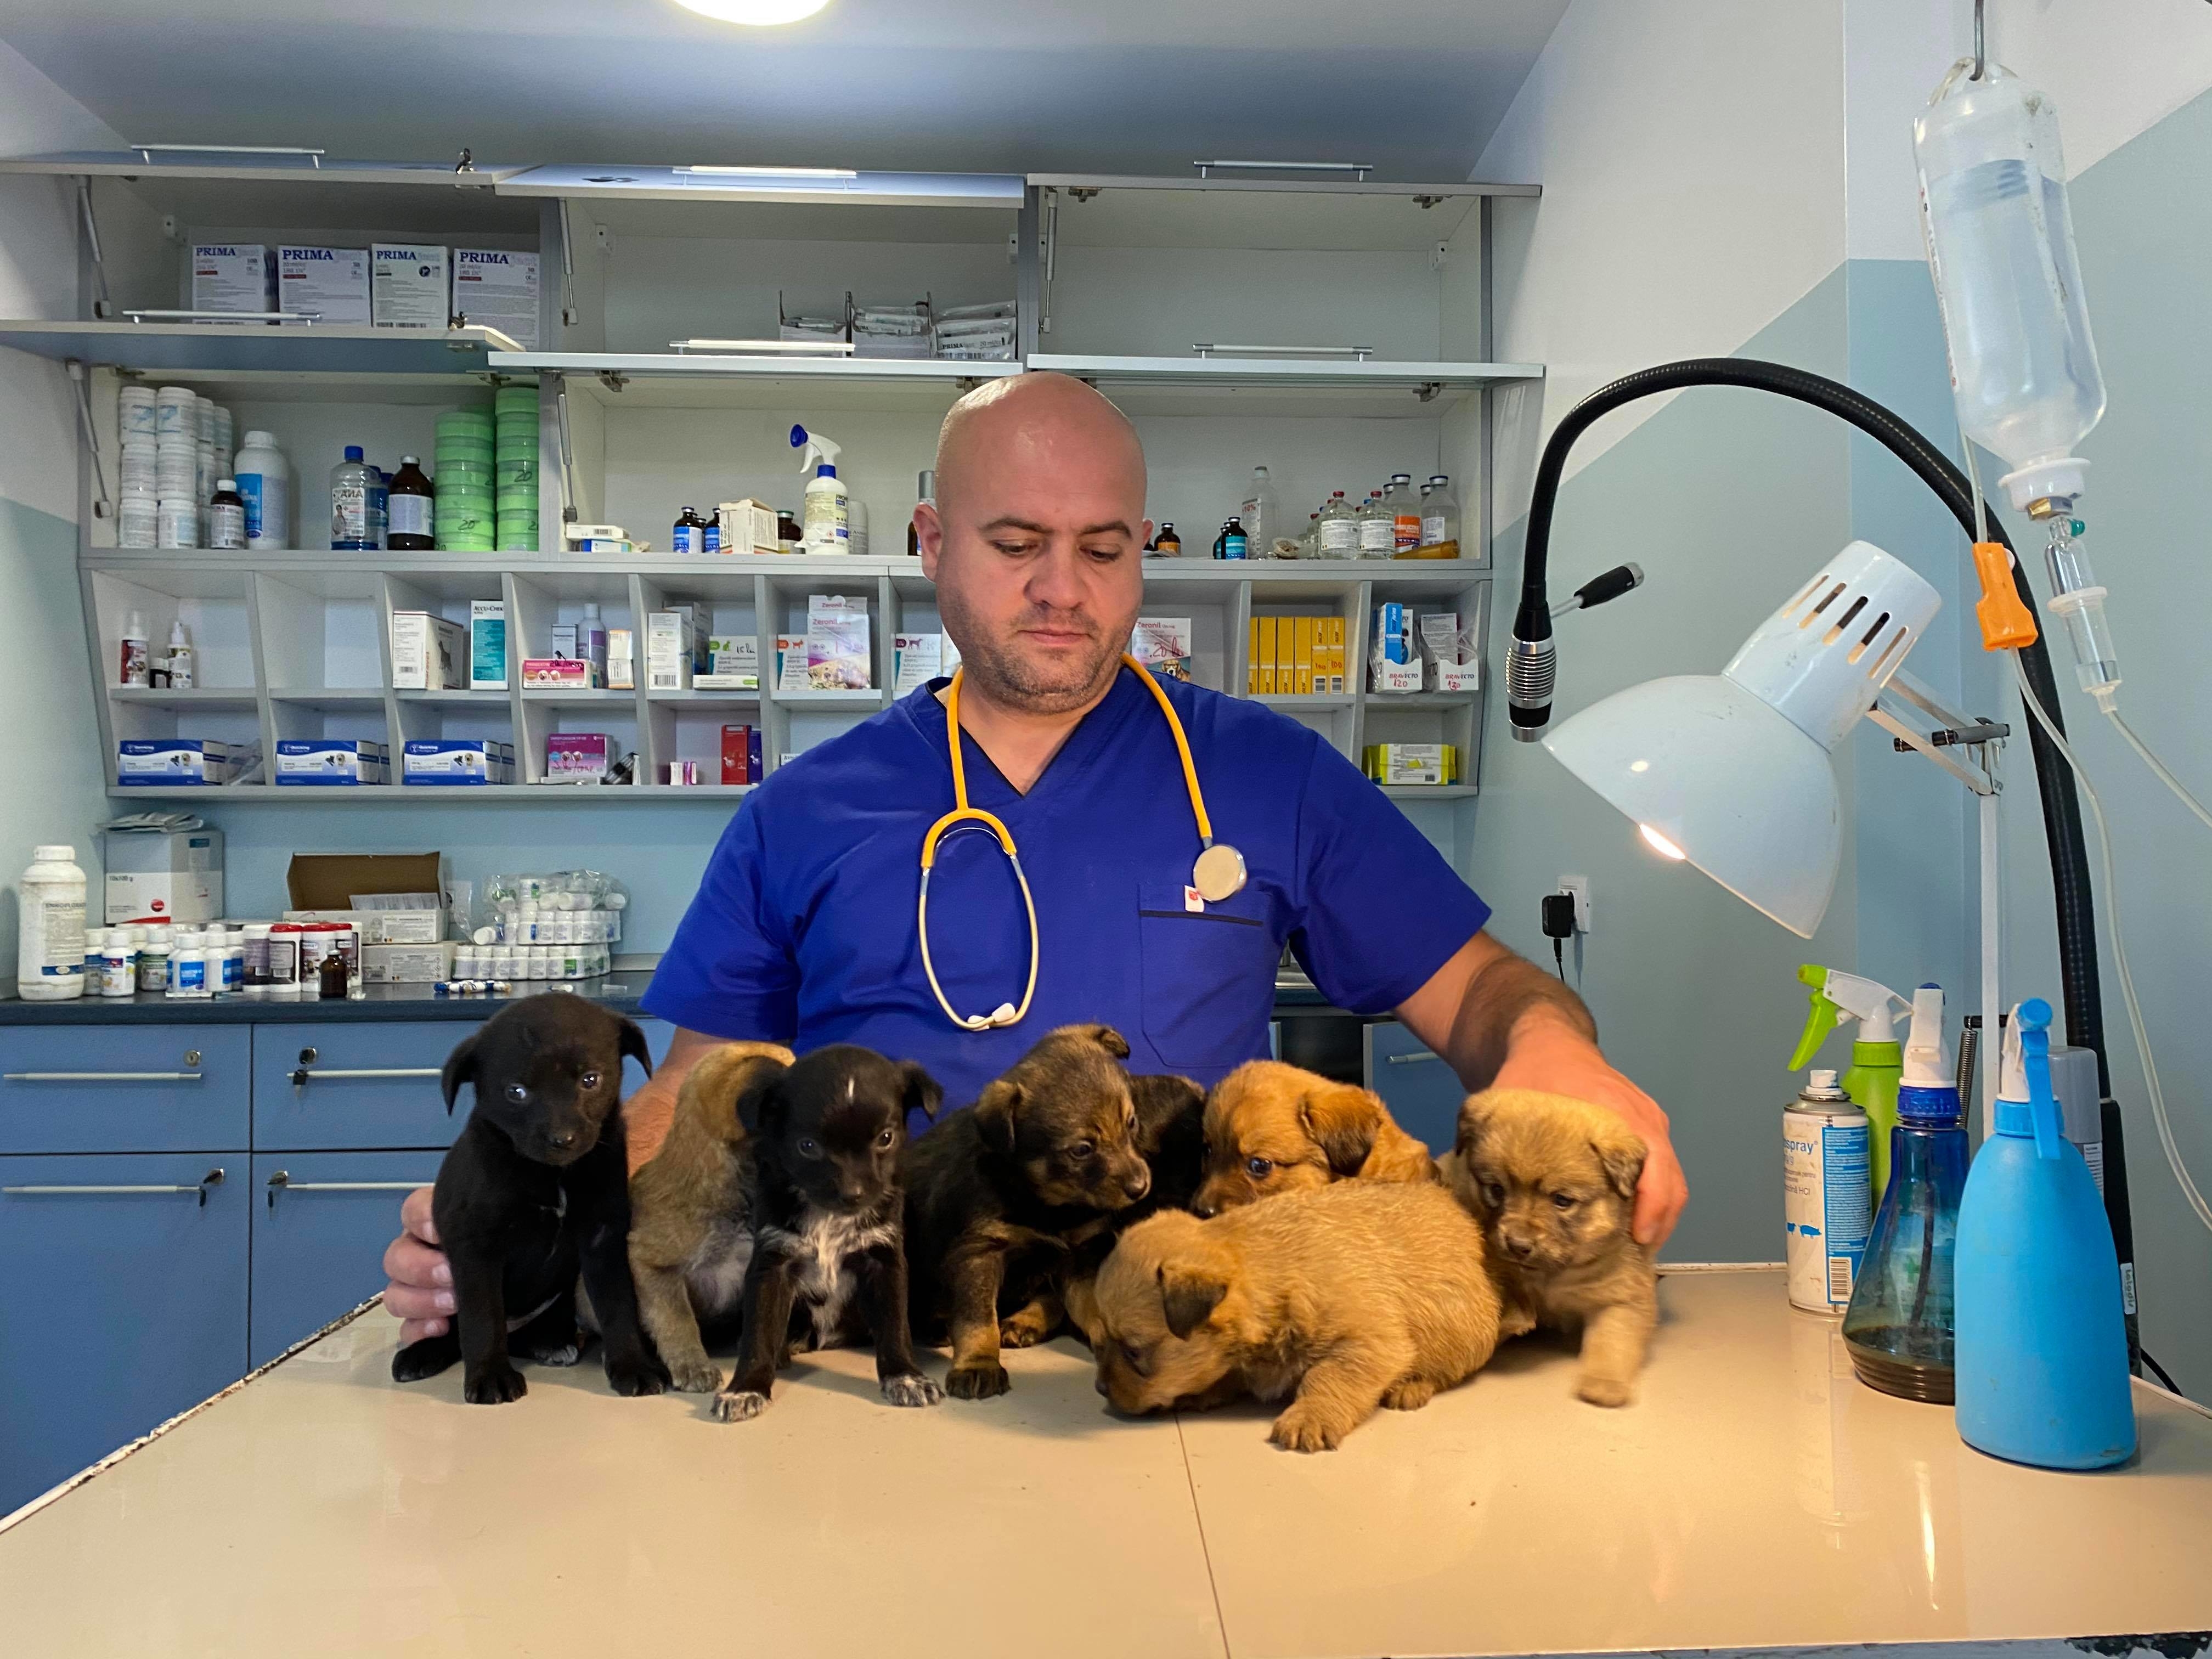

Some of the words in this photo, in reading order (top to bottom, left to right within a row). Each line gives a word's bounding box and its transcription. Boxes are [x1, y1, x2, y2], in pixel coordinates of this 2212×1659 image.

[196, 247, 236, 256] PRIMA
[283, 249, 333, 260] PRIMA
[376, 250, 416, 260] PRIMA
[459, 252, 509, 264] PRIMA
[514, 469, 532, 482] 20
[458, 520, 476, 531] 20
[1153, 642, 1167, 658] 20
[1393, 679, 1408, 687] 120
